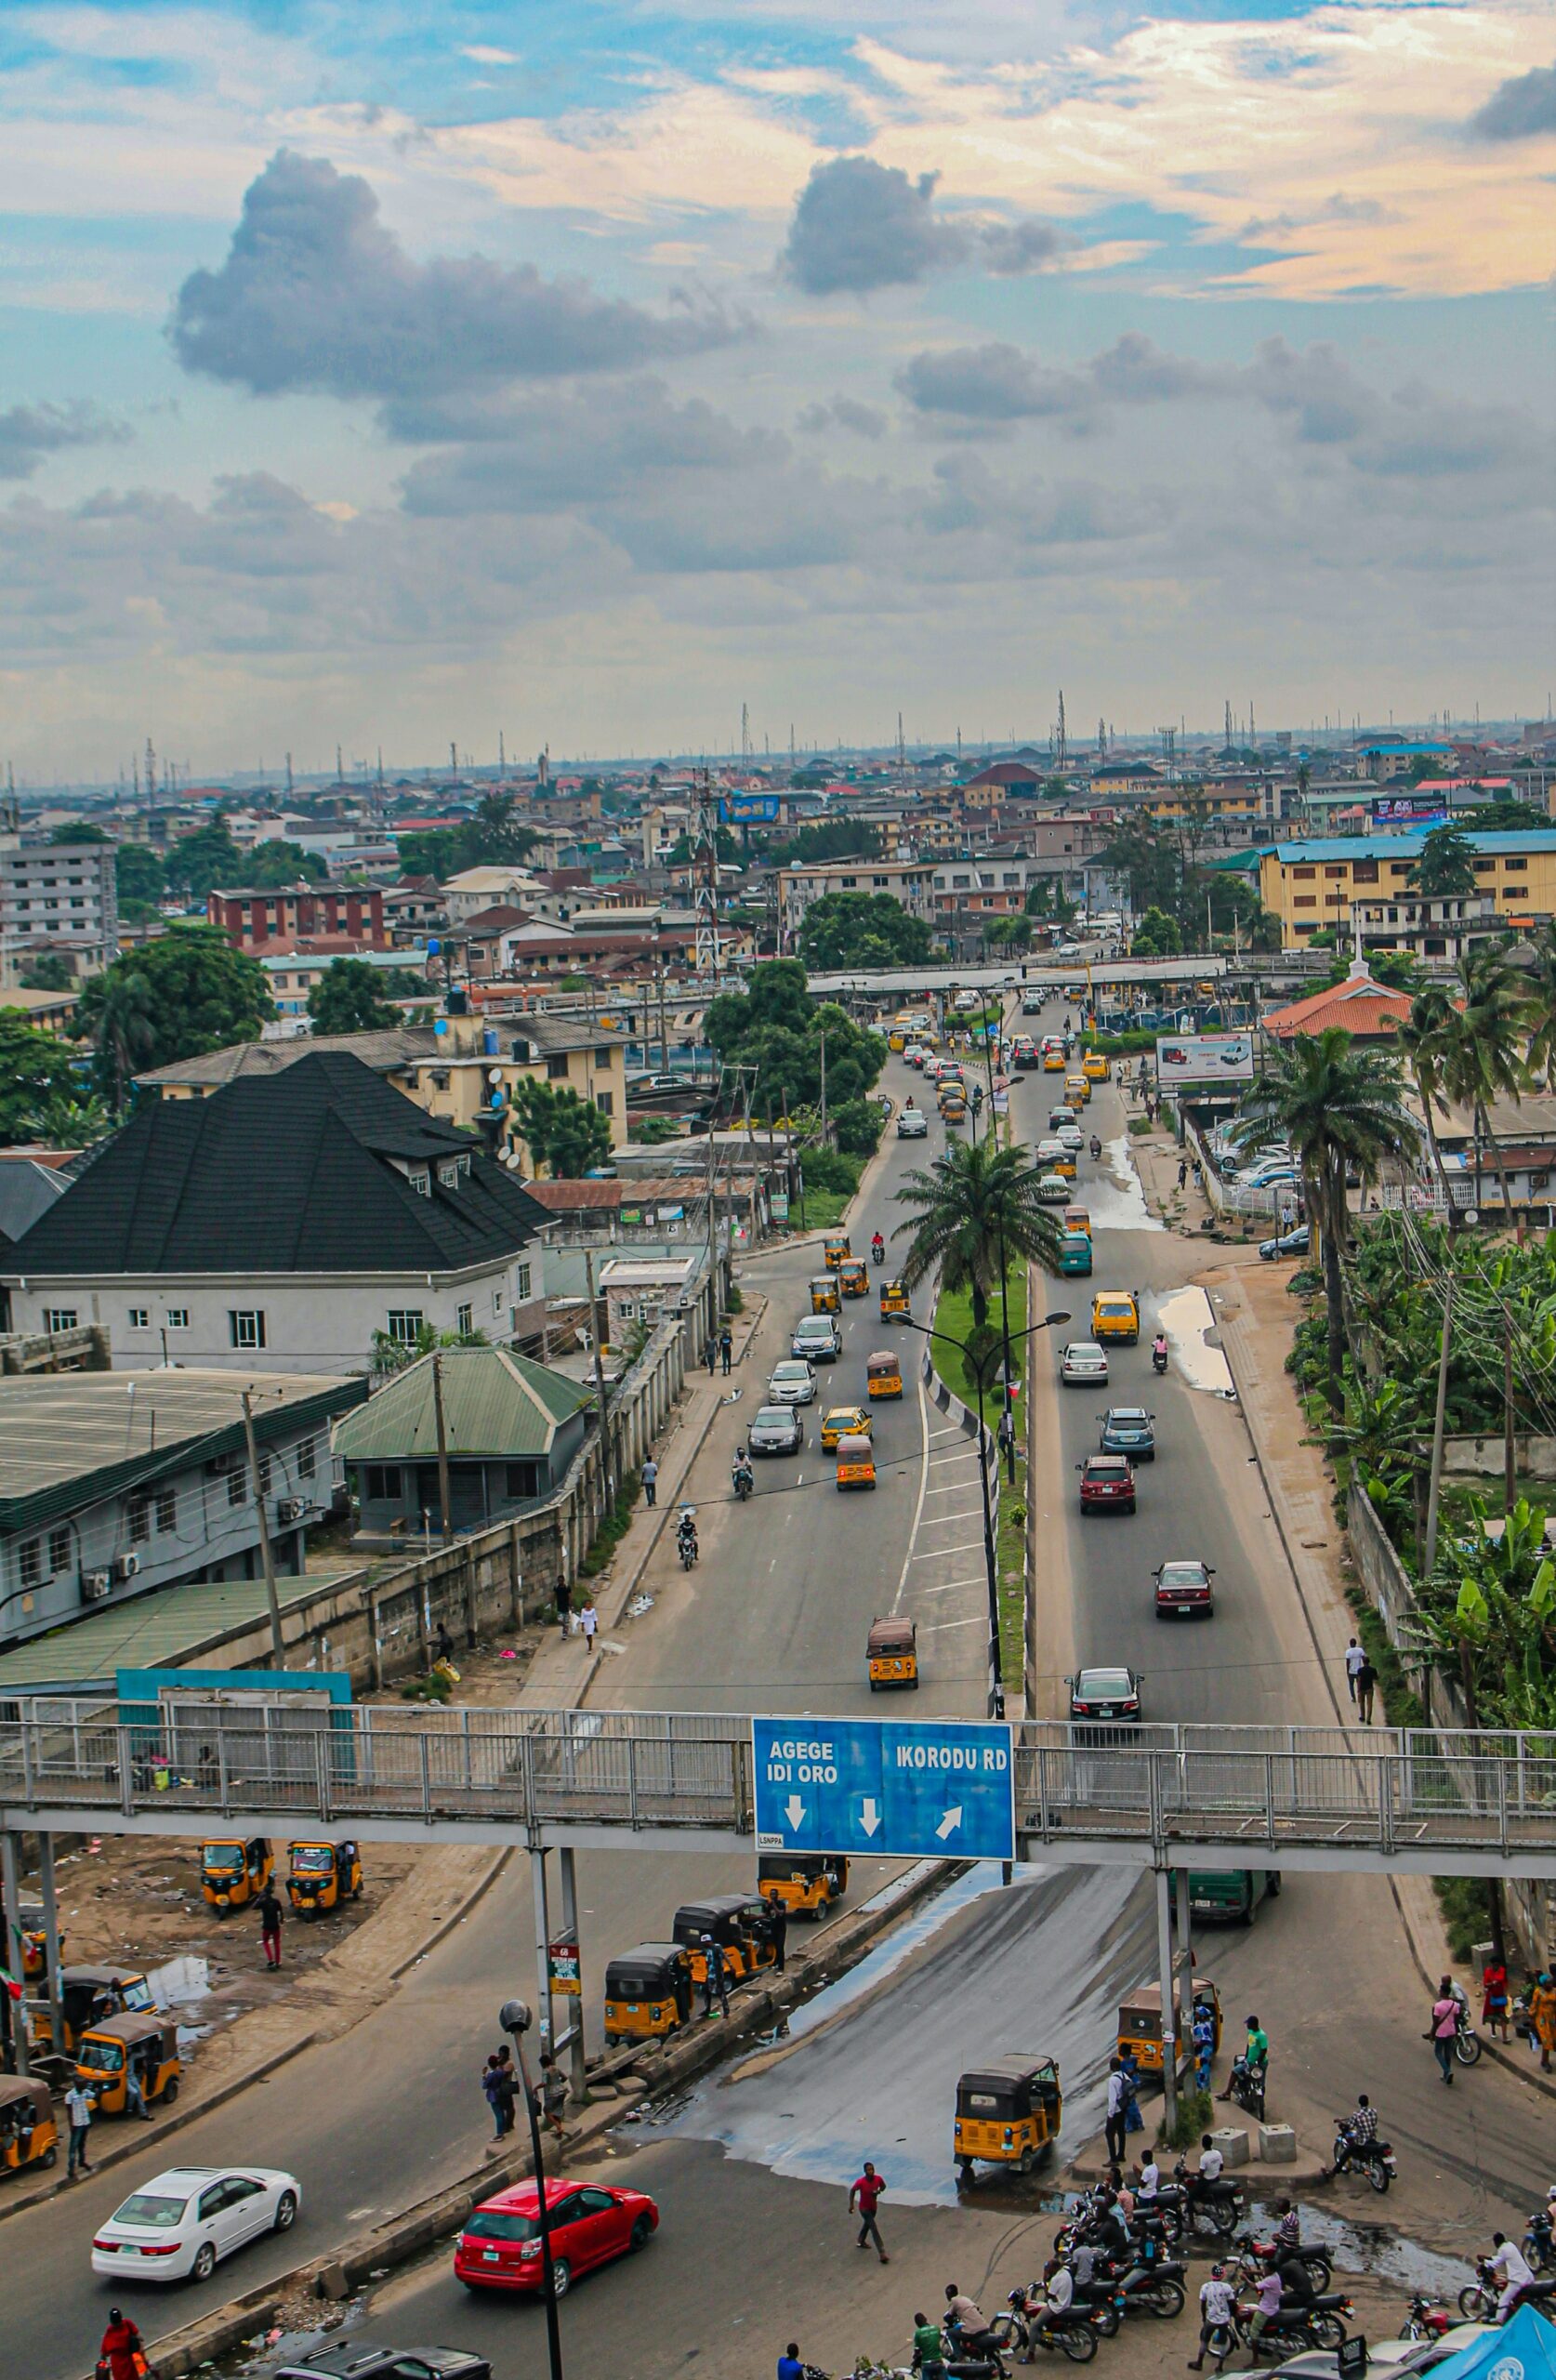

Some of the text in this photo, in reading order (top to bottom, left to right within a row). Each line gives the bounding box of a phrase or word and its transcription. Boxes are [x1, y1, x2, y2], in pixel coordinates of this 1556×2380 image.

[770, 1741, 834, 1760] AGEGE
[896, 1746, 1007, 1770] IKORODU RD
[767, 1764, 837, 1784] IDI ORO
[759, 1836, 783, 1845] LSNPPA
